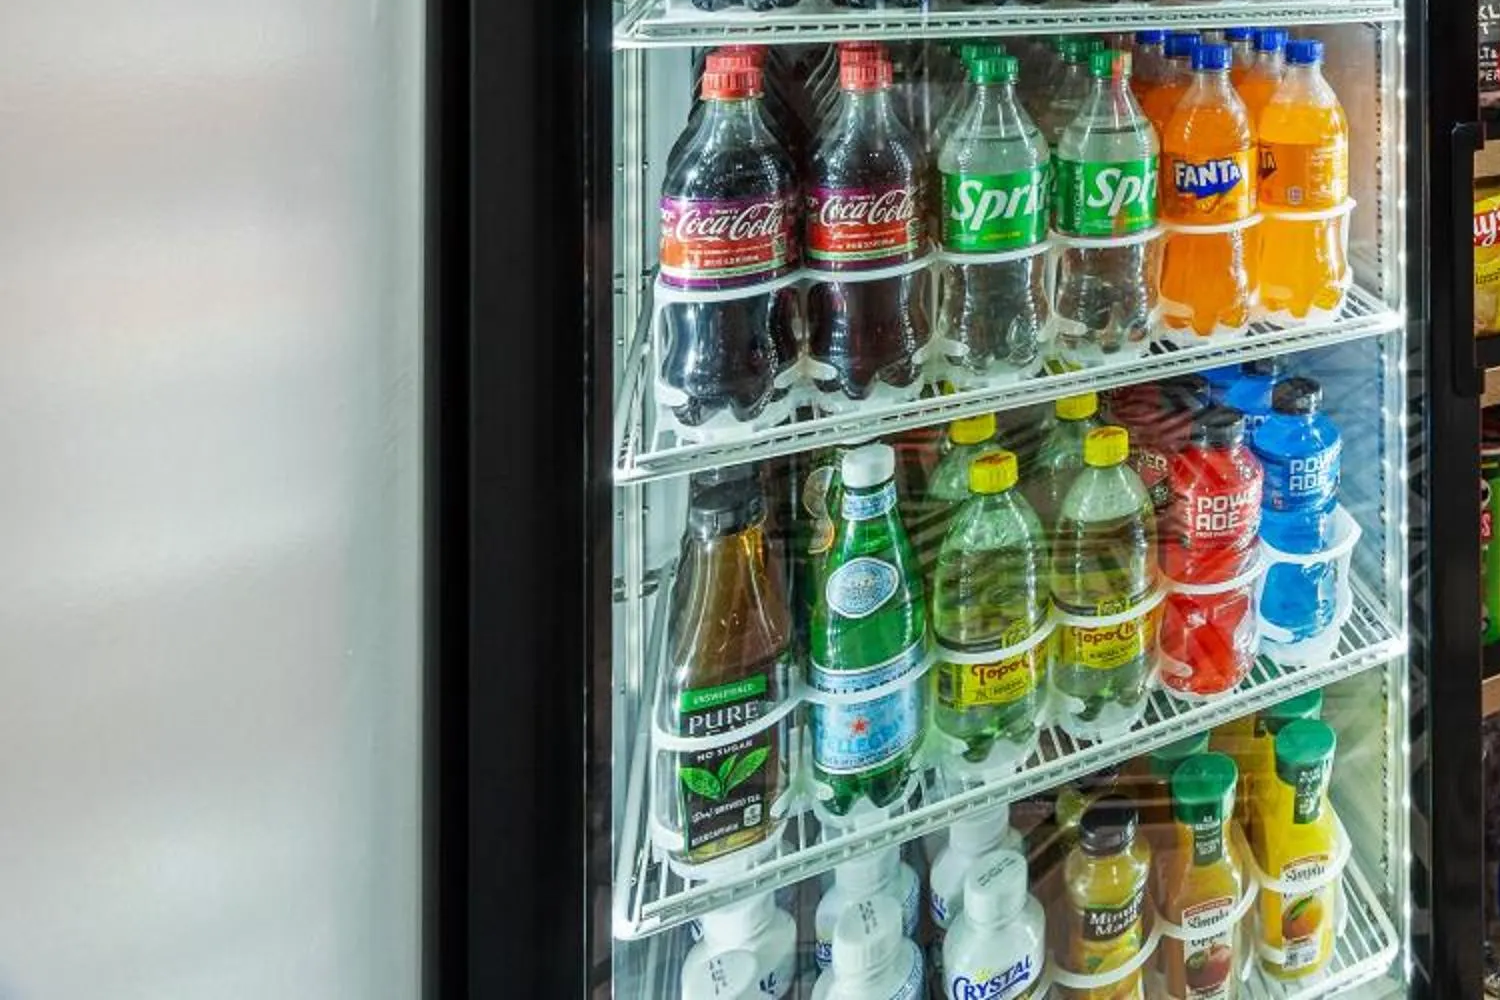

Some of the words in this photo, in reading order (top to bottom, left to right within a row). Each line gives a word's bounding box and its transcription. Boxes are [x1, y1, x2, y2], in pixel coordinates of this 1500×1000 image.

[1174, 160, 1241, 189] FANTA
[821, 189, 914, 227] Coca-Cola
[689, 700, 760, 735] PURE
[697, 750, 713, 762] NO
[953, 955, 1033, 1000] CRYSTAL
